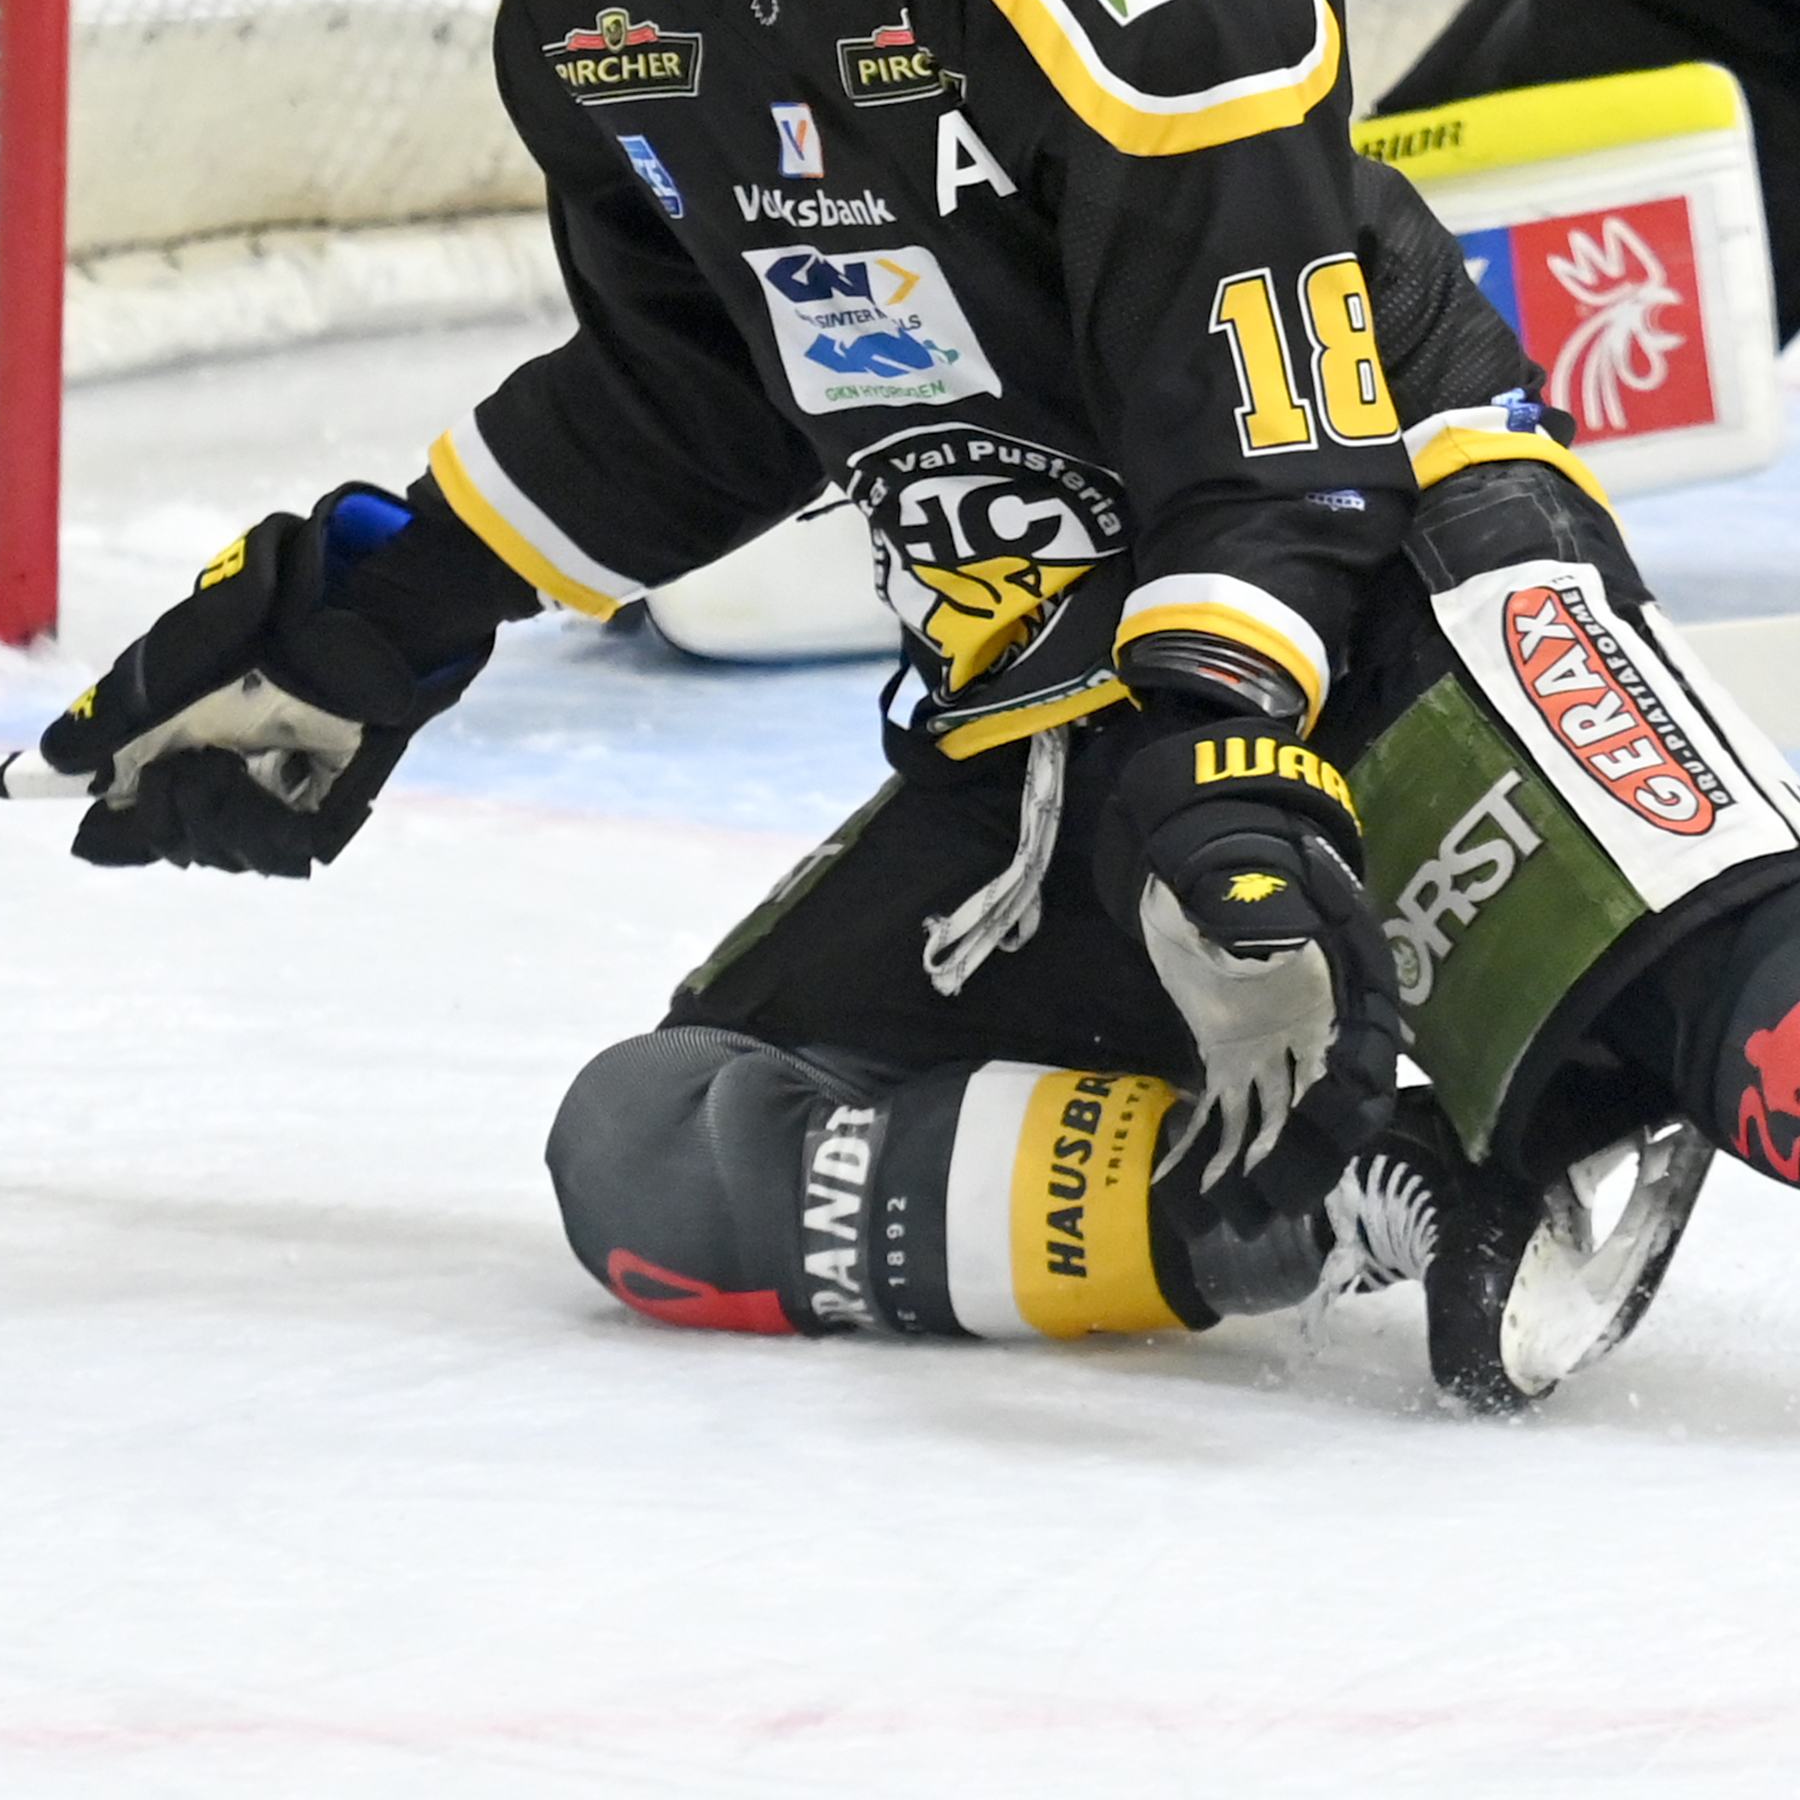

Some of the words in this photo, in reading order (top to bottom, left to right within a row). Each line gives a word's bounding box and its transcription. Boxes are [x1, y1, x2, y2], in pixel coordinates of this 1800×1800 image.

[857, 52, 933, 85] PIRC
[936, 109, 1020, 217] A
[1359, 120, 1464, 162] RIOR
[1208, 251, 1404, 459] 18
[967, 440, 1123, 537] Pusteria
[1514, 594, 1701, 824] GERAX
[1194, 736, 1364, 837] WAR
[1381, 768, 1545, 1010] ORST
[802, 1102, 880, 1326] RANDT
[1044, 1068, 1118, 1281] HAUSBR
[886, 1193, 909, 1288] 1892
